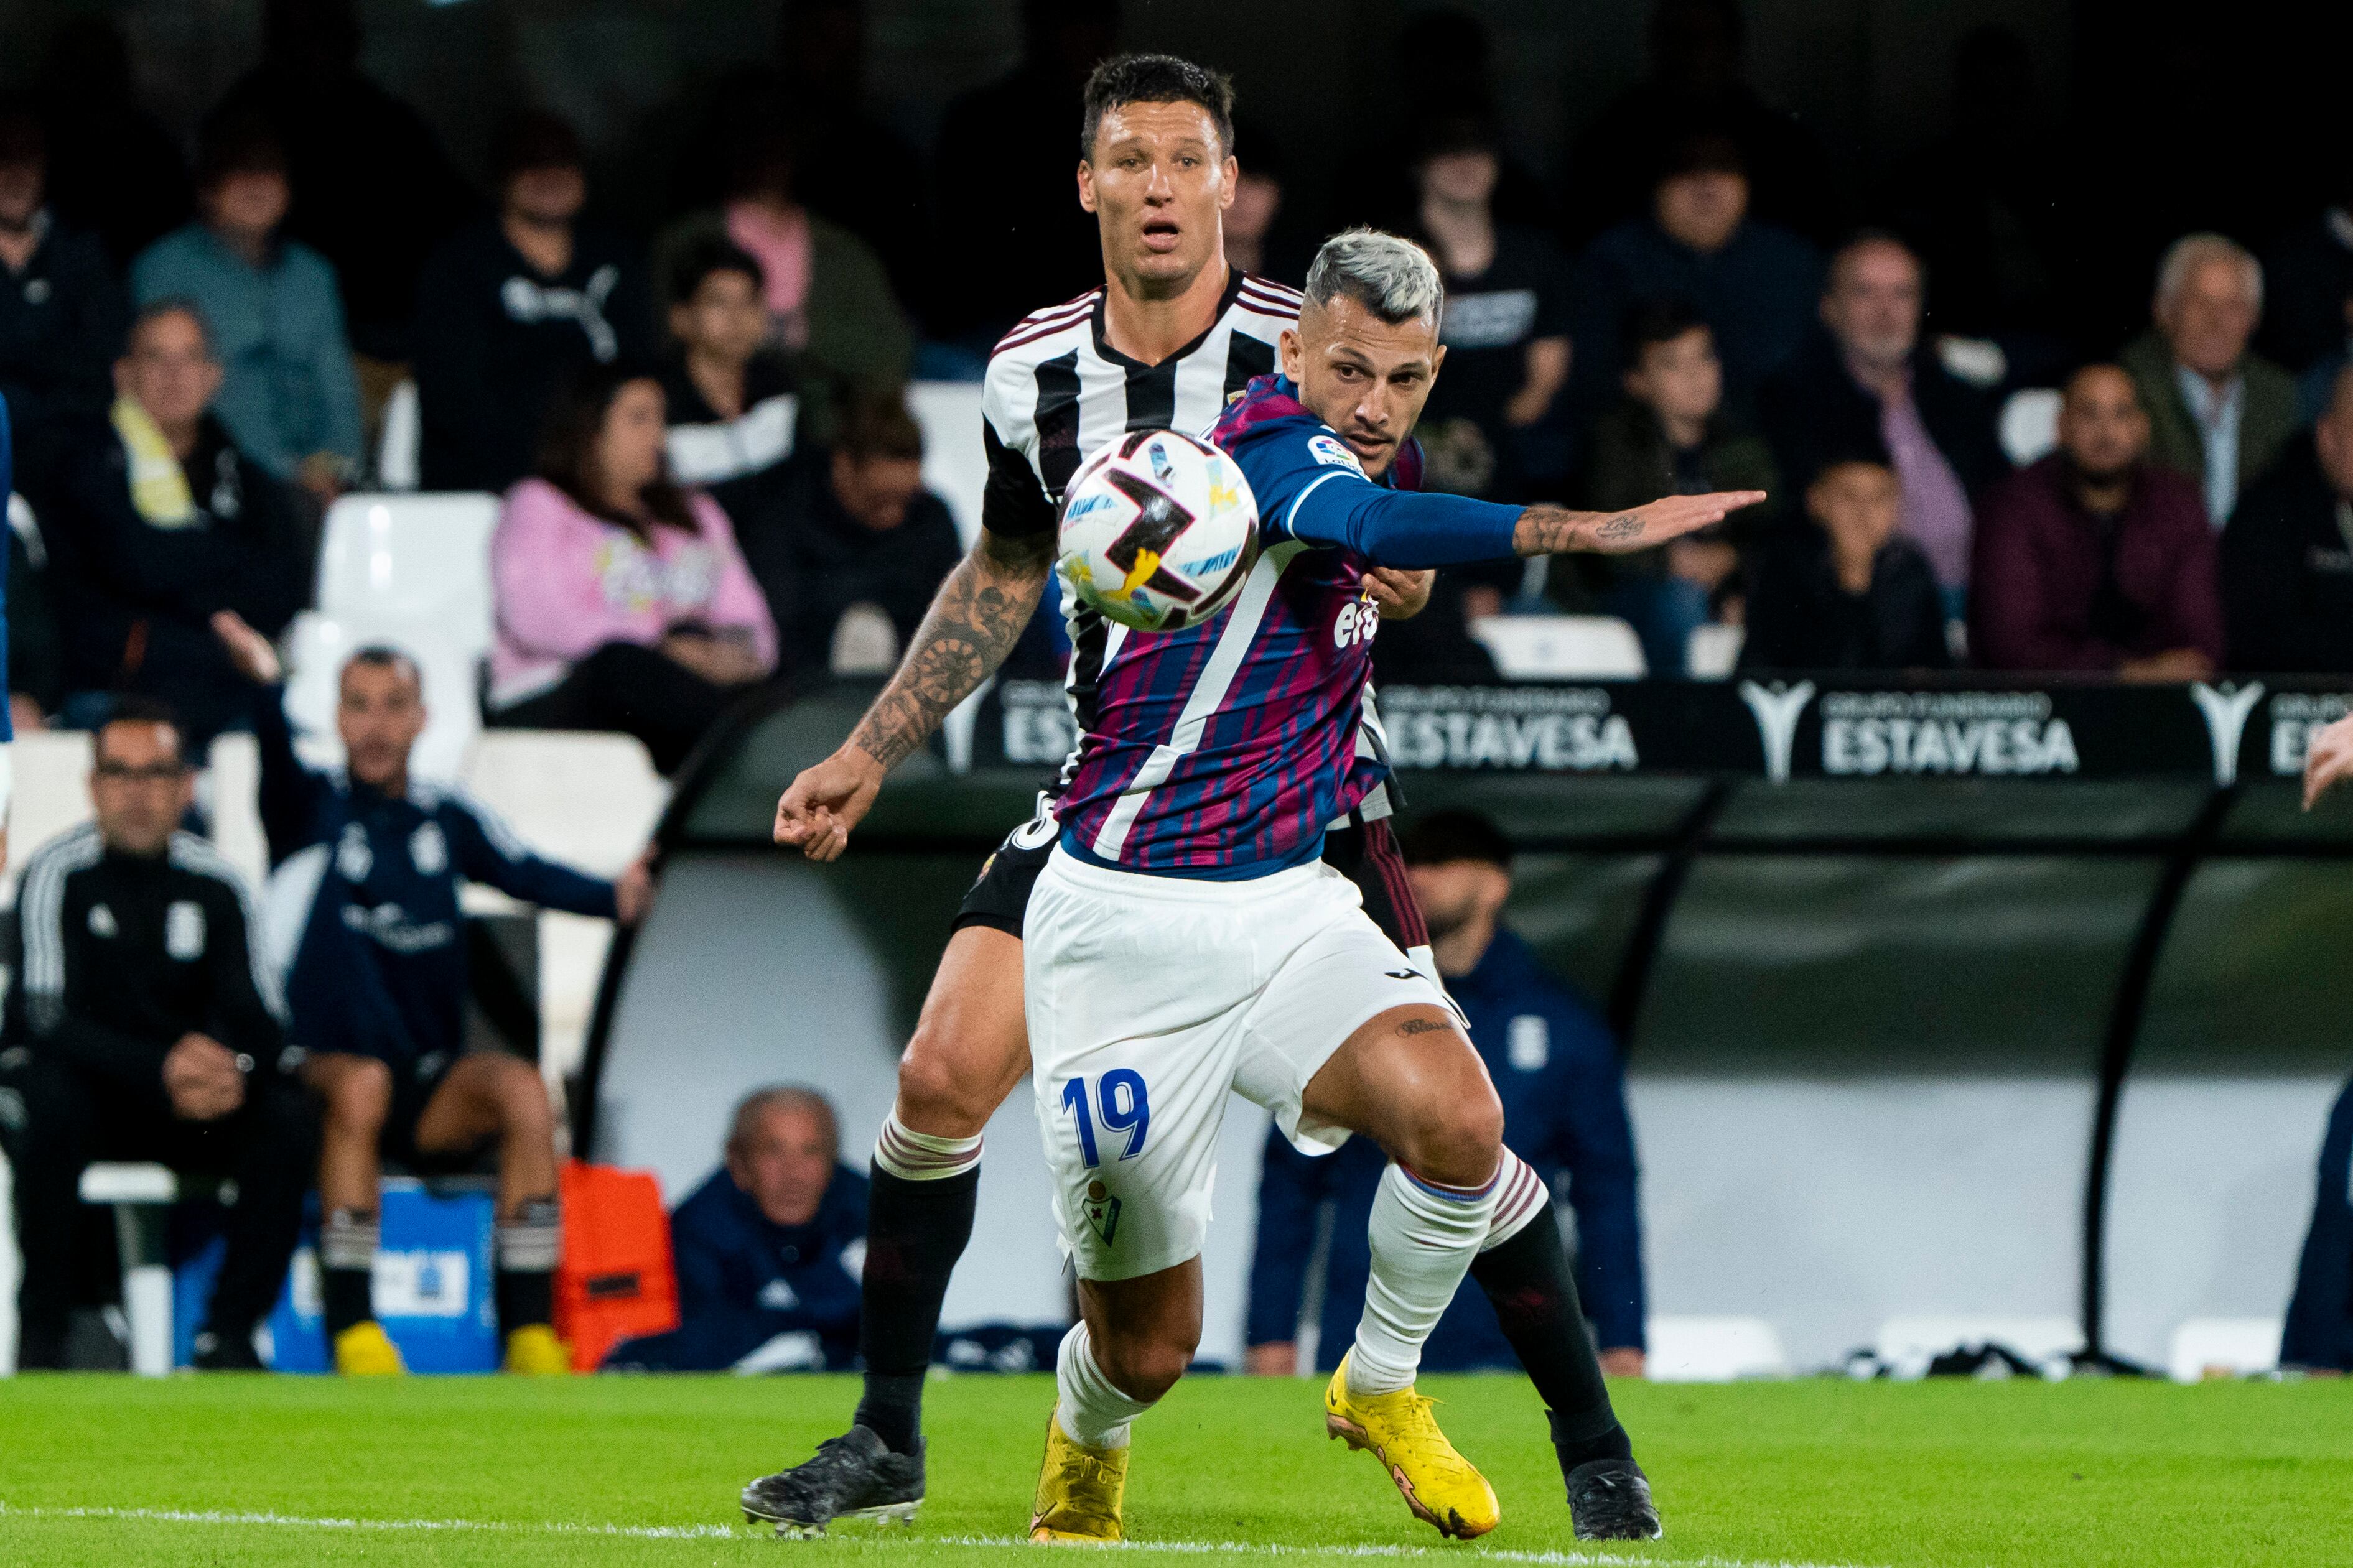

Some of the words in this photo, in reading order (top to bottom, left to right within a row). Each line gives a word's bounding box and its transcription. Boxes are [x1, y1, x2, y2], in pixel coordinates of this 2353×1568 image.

[1382, 712, 1639, 770] ESTAVESA
[1823, 718, 2080, 774] ESTAVESA
[1060, 1068, 1150, 1169] 19
